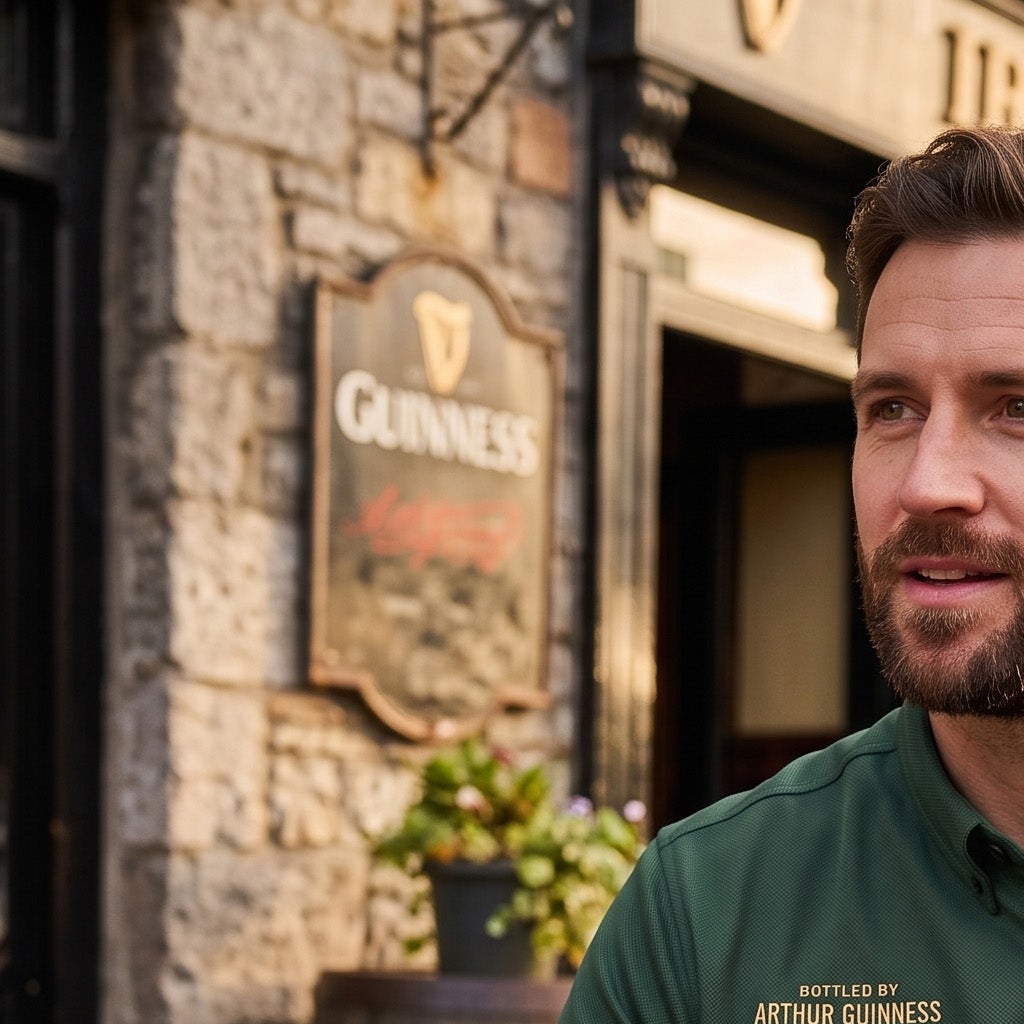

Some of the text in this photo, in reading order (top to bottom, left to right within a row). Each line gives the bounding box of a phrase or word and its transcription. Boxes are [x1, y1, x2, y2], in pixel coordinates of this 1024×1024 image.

[335, 370, 539, 478] GUINNESS
[800, 983, 899, 998] BOTTLED BY
